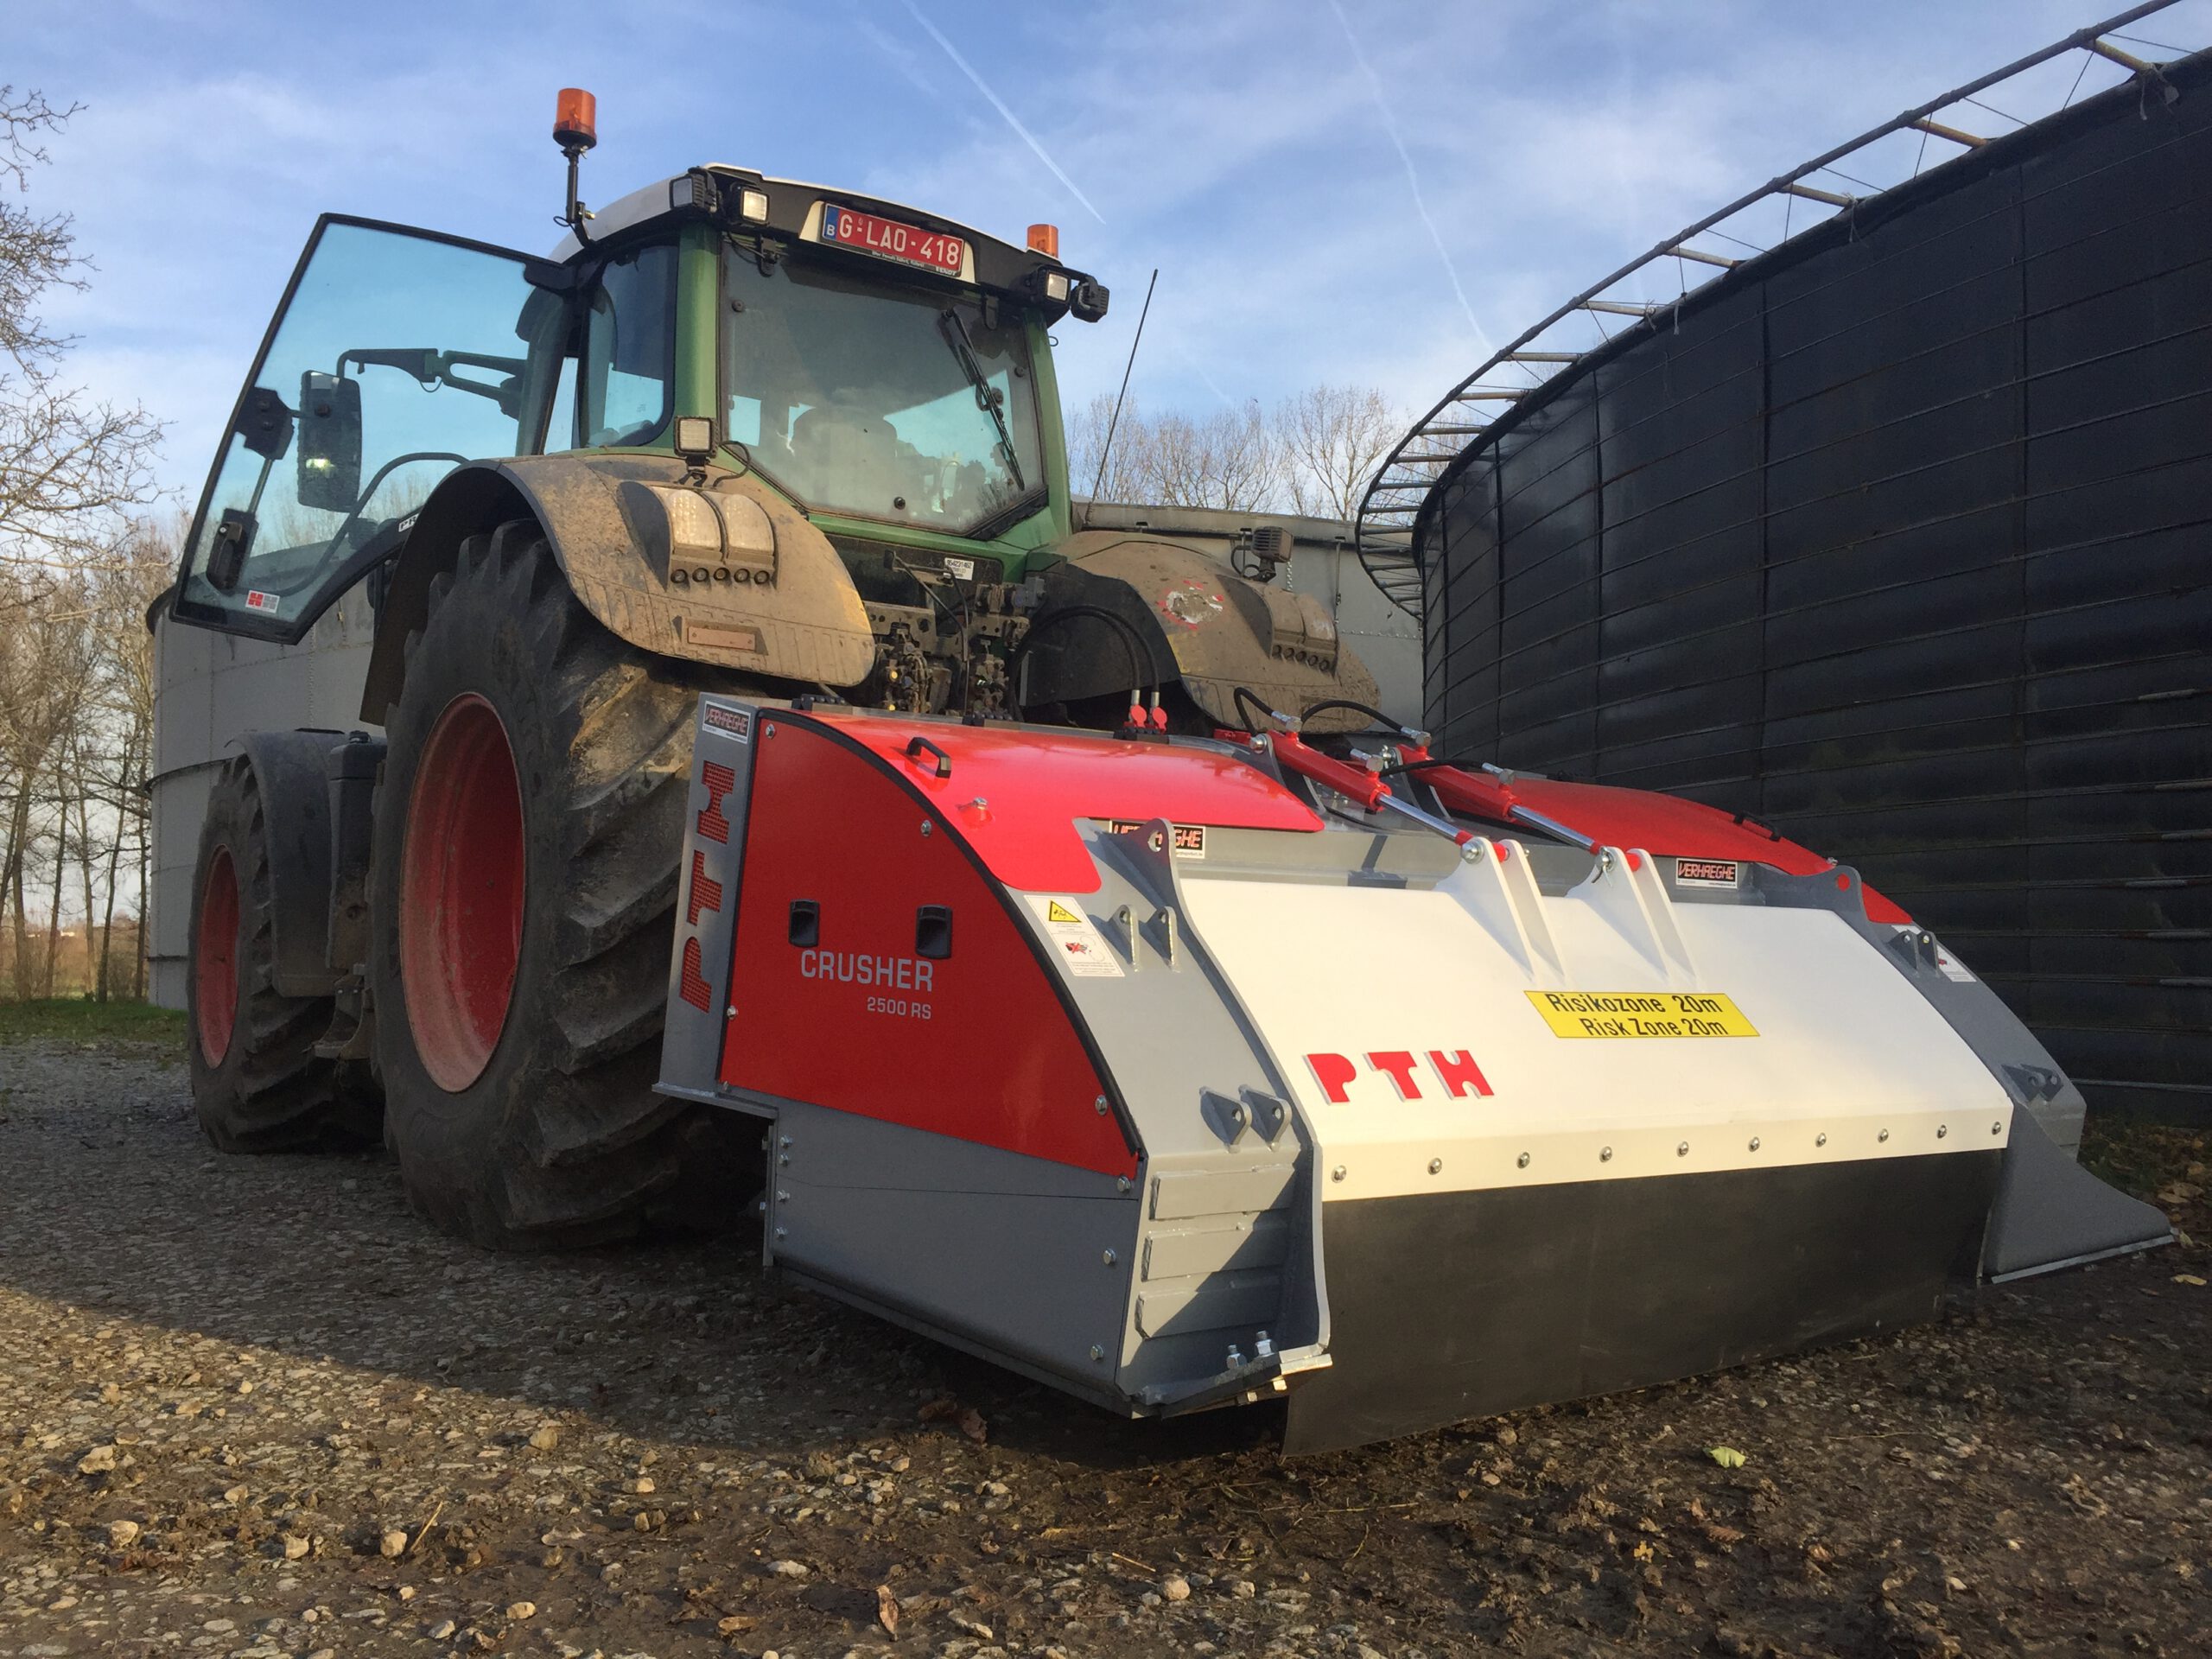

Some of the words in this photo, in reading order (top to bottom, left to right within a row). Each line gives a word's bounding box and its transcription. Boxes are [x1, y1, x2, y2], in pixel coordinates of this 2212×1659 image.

[826, 224, 836, 237] B
[705, 706, 749, 734] VERHAEGHE
[1678, 861, 1735, 880] VERHAEGHE
[801, 949, 934, 992] CRUSHER
[867, 996, 906, 1016] 2500
[911, 1001, 932, 1020] RS
[1544, 993, 1666, 1013] Risikozone
[1672, 995, 1723, 1013] 20m
[1579, 1018, 1632, 1036] Risk
[1628, 1018, 1681, 1036] Zone
[1682, 1018, 1729, 1036] 20m
[1304, 1049, 1495, 1104] PTH
